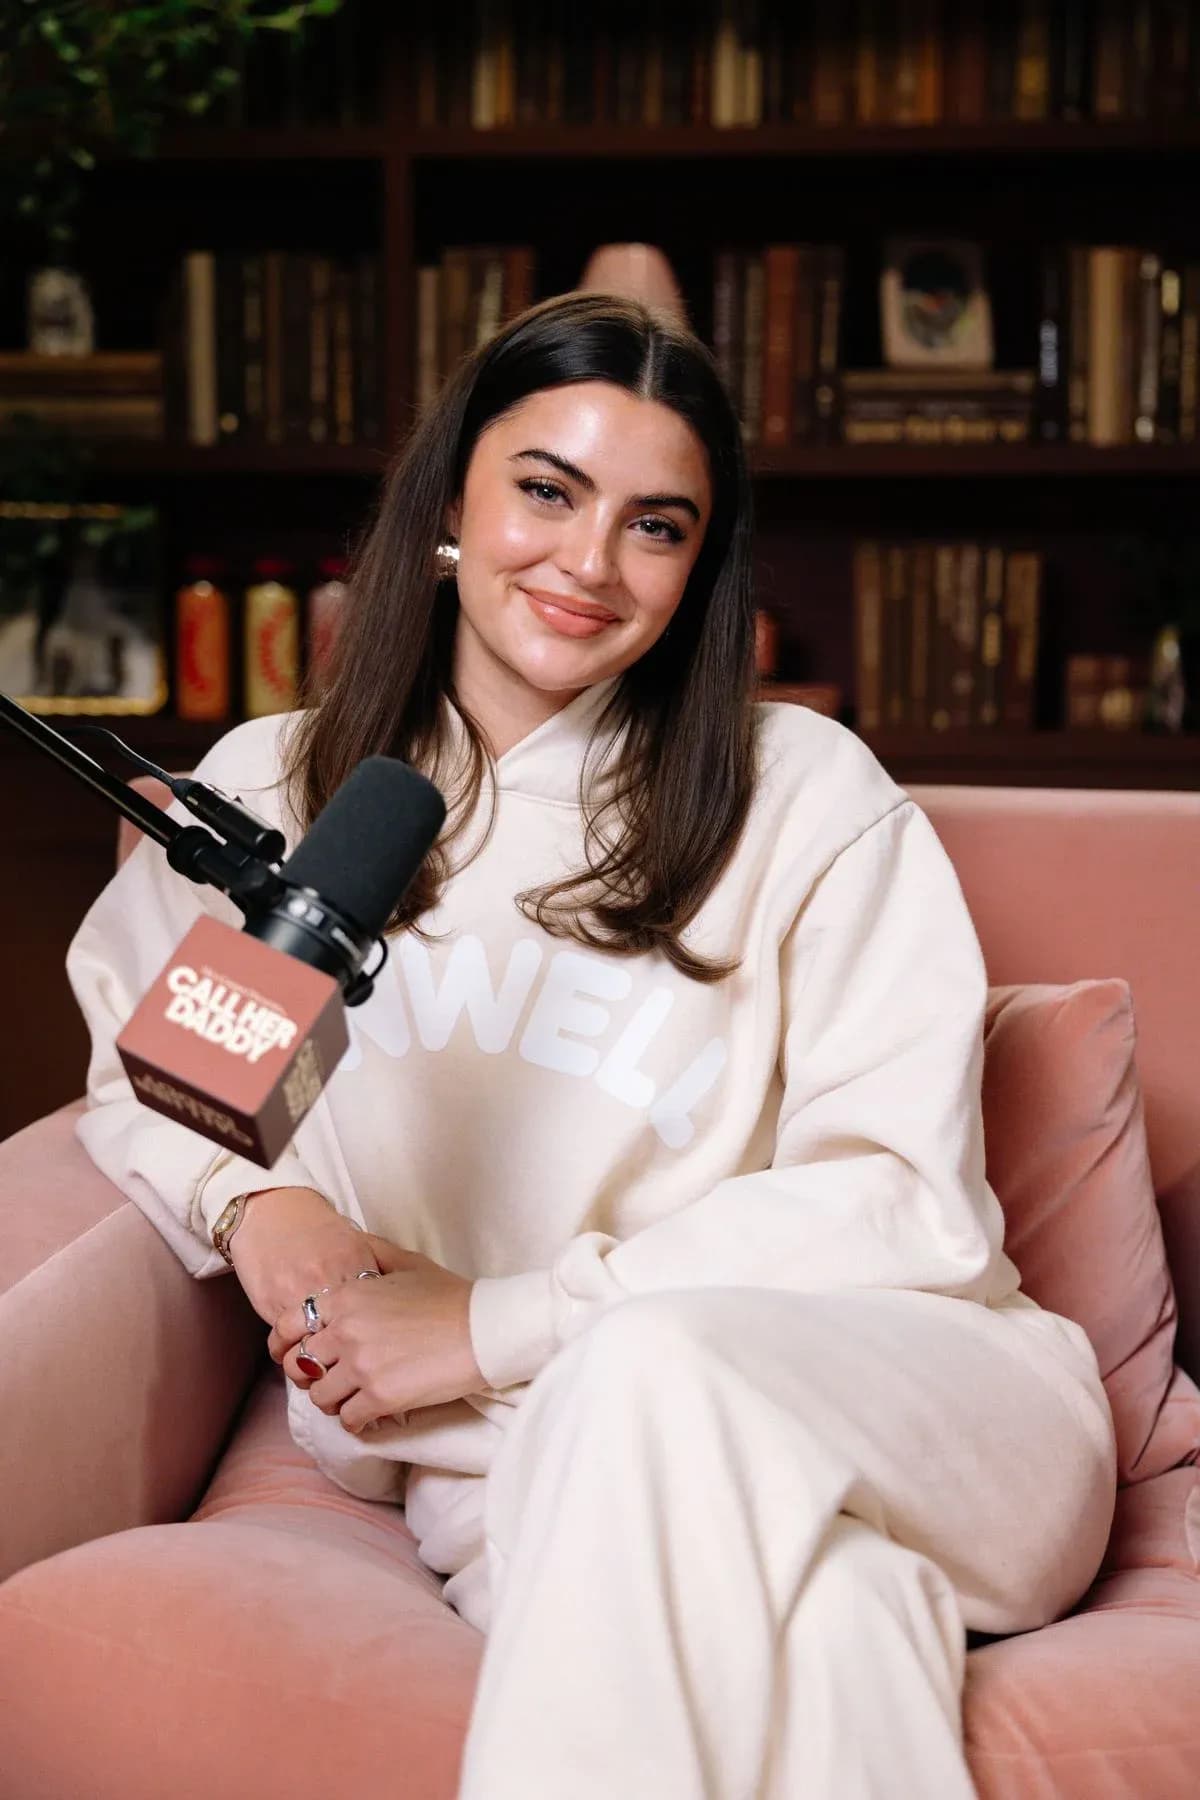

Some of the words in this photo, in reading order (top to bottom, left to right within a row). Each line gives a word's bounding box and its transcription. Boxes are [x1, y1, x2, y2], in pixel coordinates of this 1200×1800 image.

[165, 993, 278, 1064] DADDY
[167, 966, 241, 1018] CALL
[240, 1001, 298, 1050] HER
[338, 933, 728, 1150] NWELL
